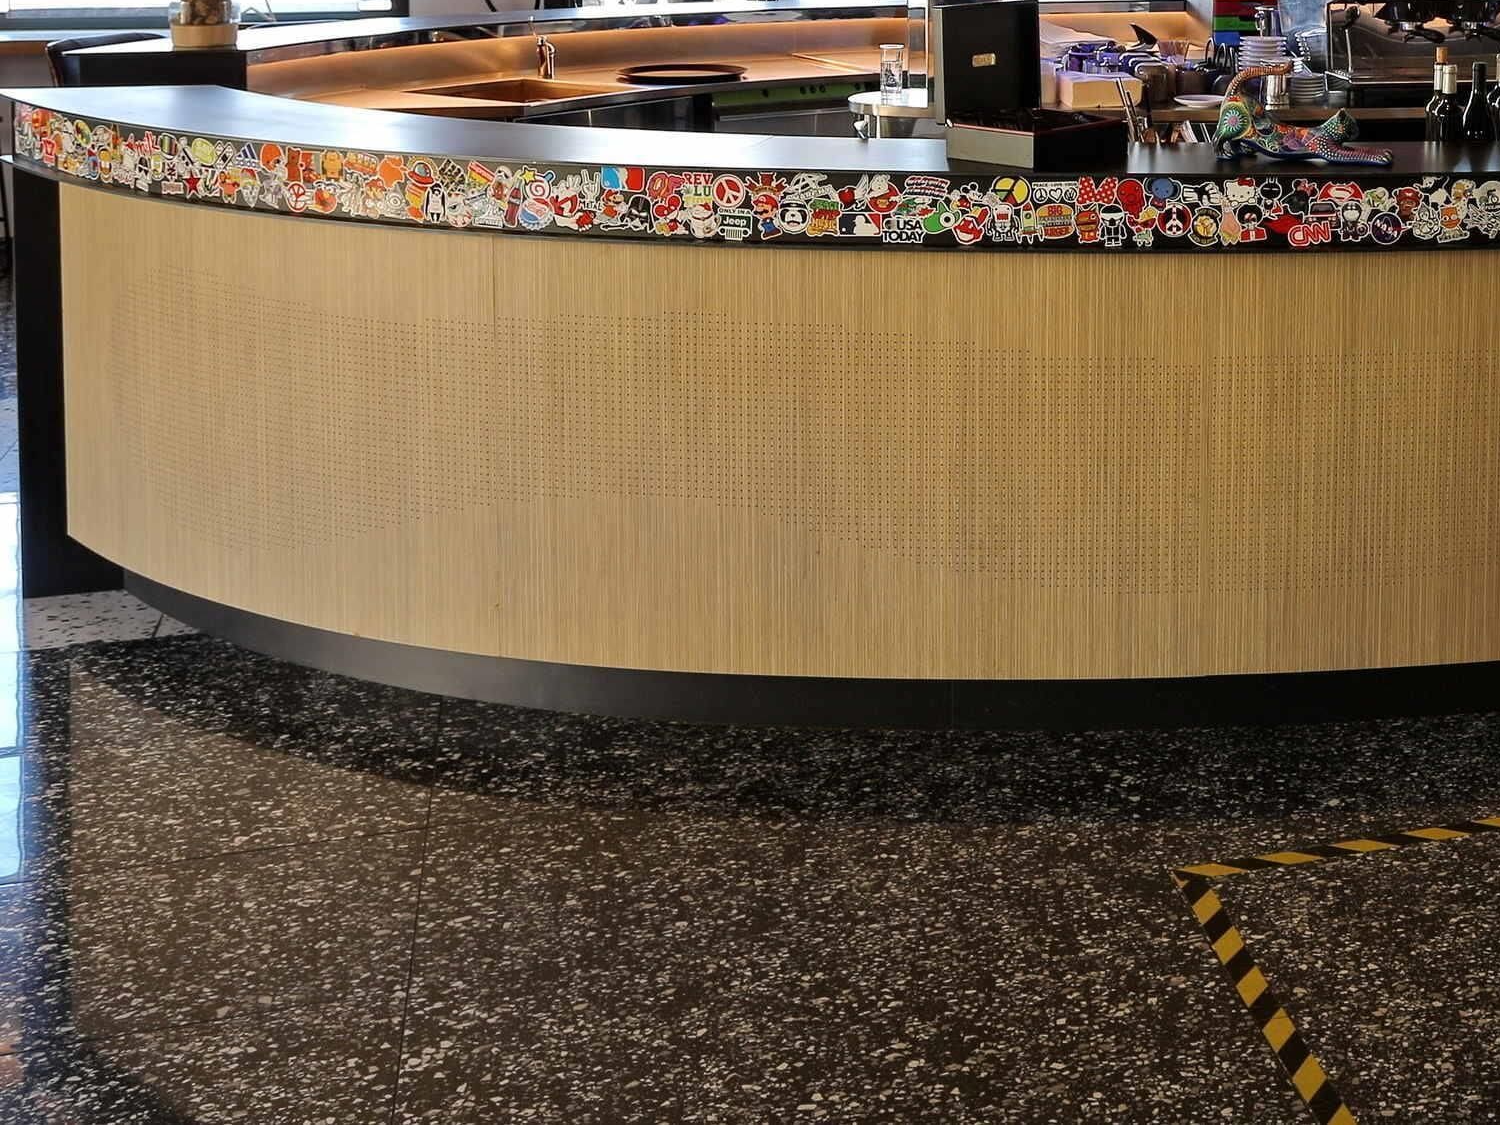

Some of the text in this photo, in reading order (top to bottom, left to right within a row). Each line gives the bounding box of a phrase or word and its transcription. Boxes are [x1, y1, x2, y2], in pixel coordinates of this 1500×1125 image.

[579, 200, 603, 211] METAL
[722, 216, 747, 227] Jeep
[897, 219, 922, 231] USA
[882, 231, 924, 243] TODAY
[1289, 221, 1331, 246] CNN
